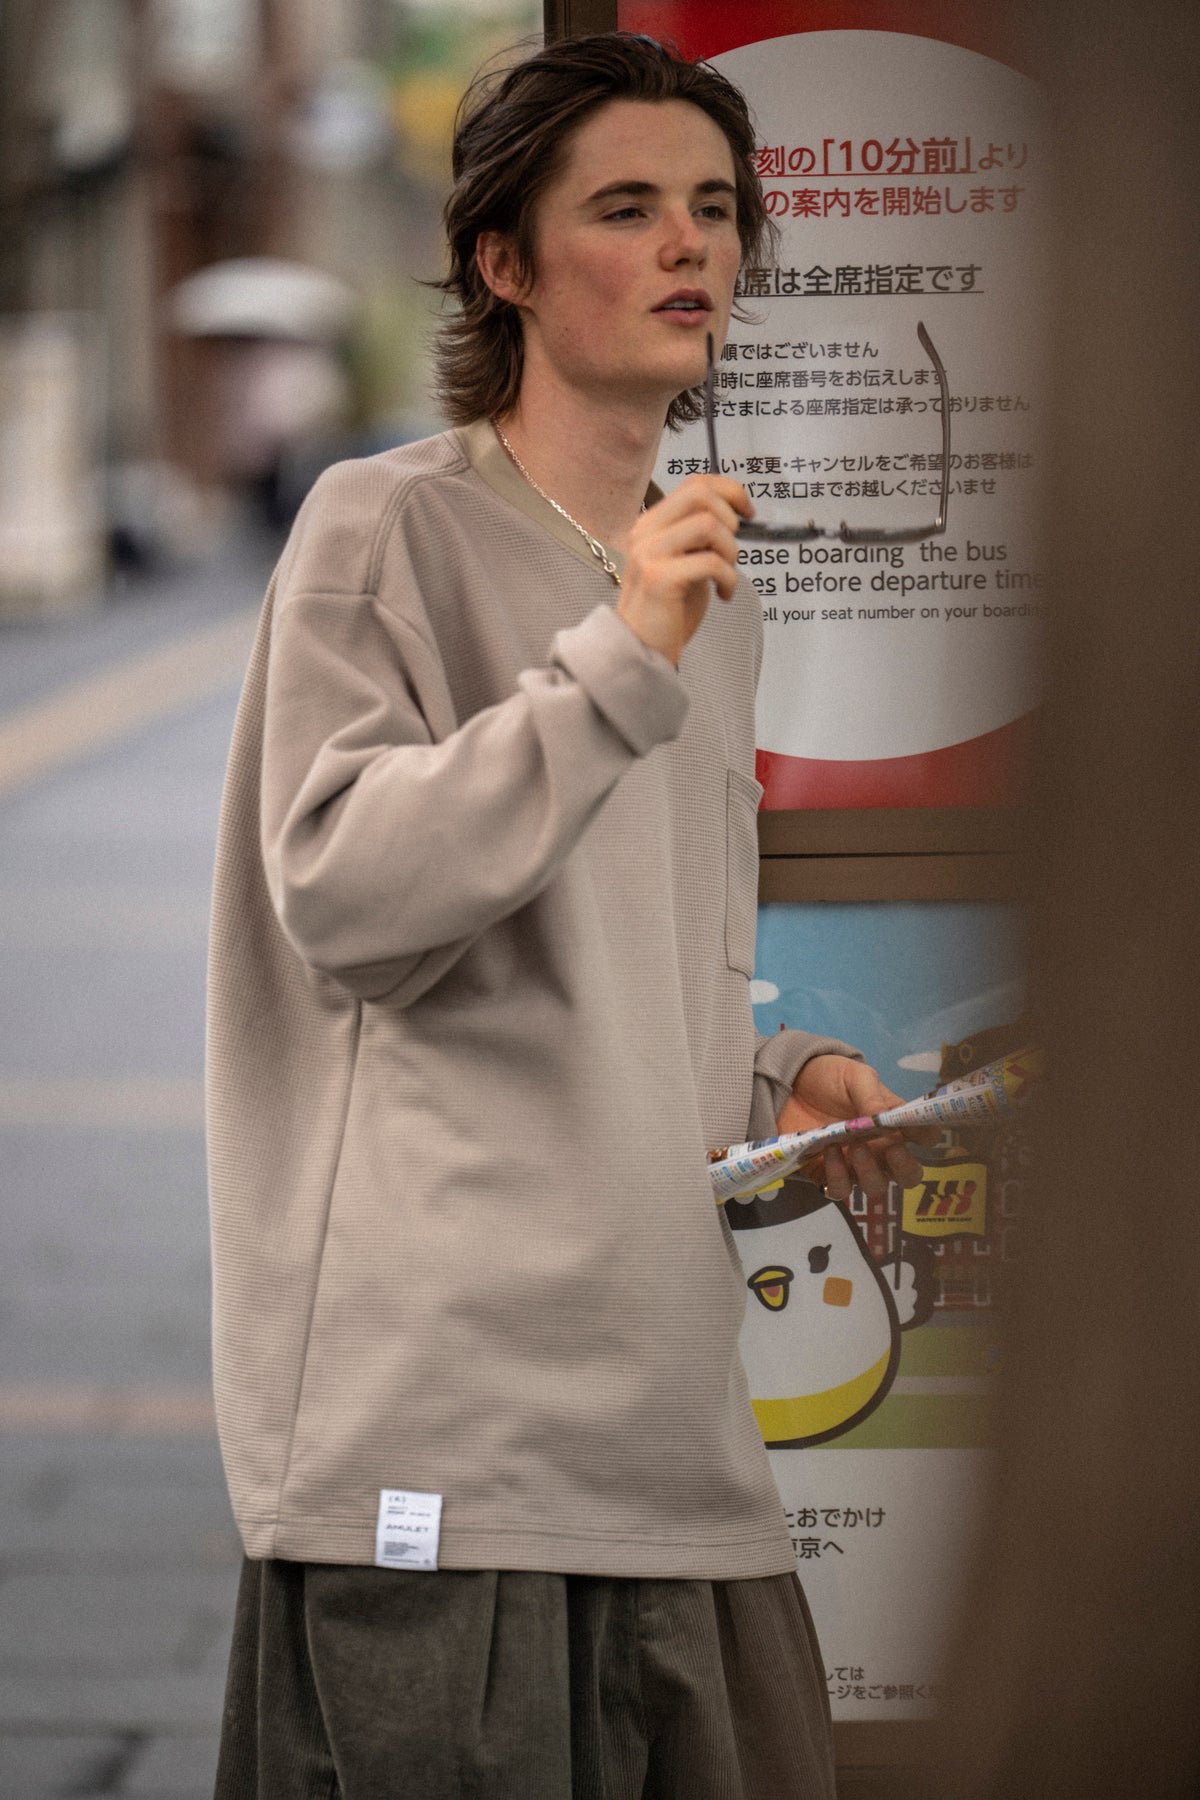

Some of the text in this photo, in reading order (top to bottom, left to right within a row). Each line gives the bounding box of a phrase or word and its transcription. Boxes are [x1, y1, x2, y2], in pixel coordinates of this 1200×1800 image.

[748, 137, 1028, 176] 刻の「10分前」より
[763, 185, 1026, 218] の案内を開始します
[735, 264, 984, 296] 席は全席指定です
[720, 341, 879, 362] 順ではございません
[799, 544, 904, 568] boarding
[920, 541, 957, 562] the
[967, 541, 1007, 561] bus
[785, 571, 862, 593] before
[871, 570, 987, 597] departure
[783, 609, 816, 625] your
[822, 607, 853, 620] seat
[858, 605, 915, 620] number
[920, 606, 940, 619] on
[945, 606, 978, 622] your
